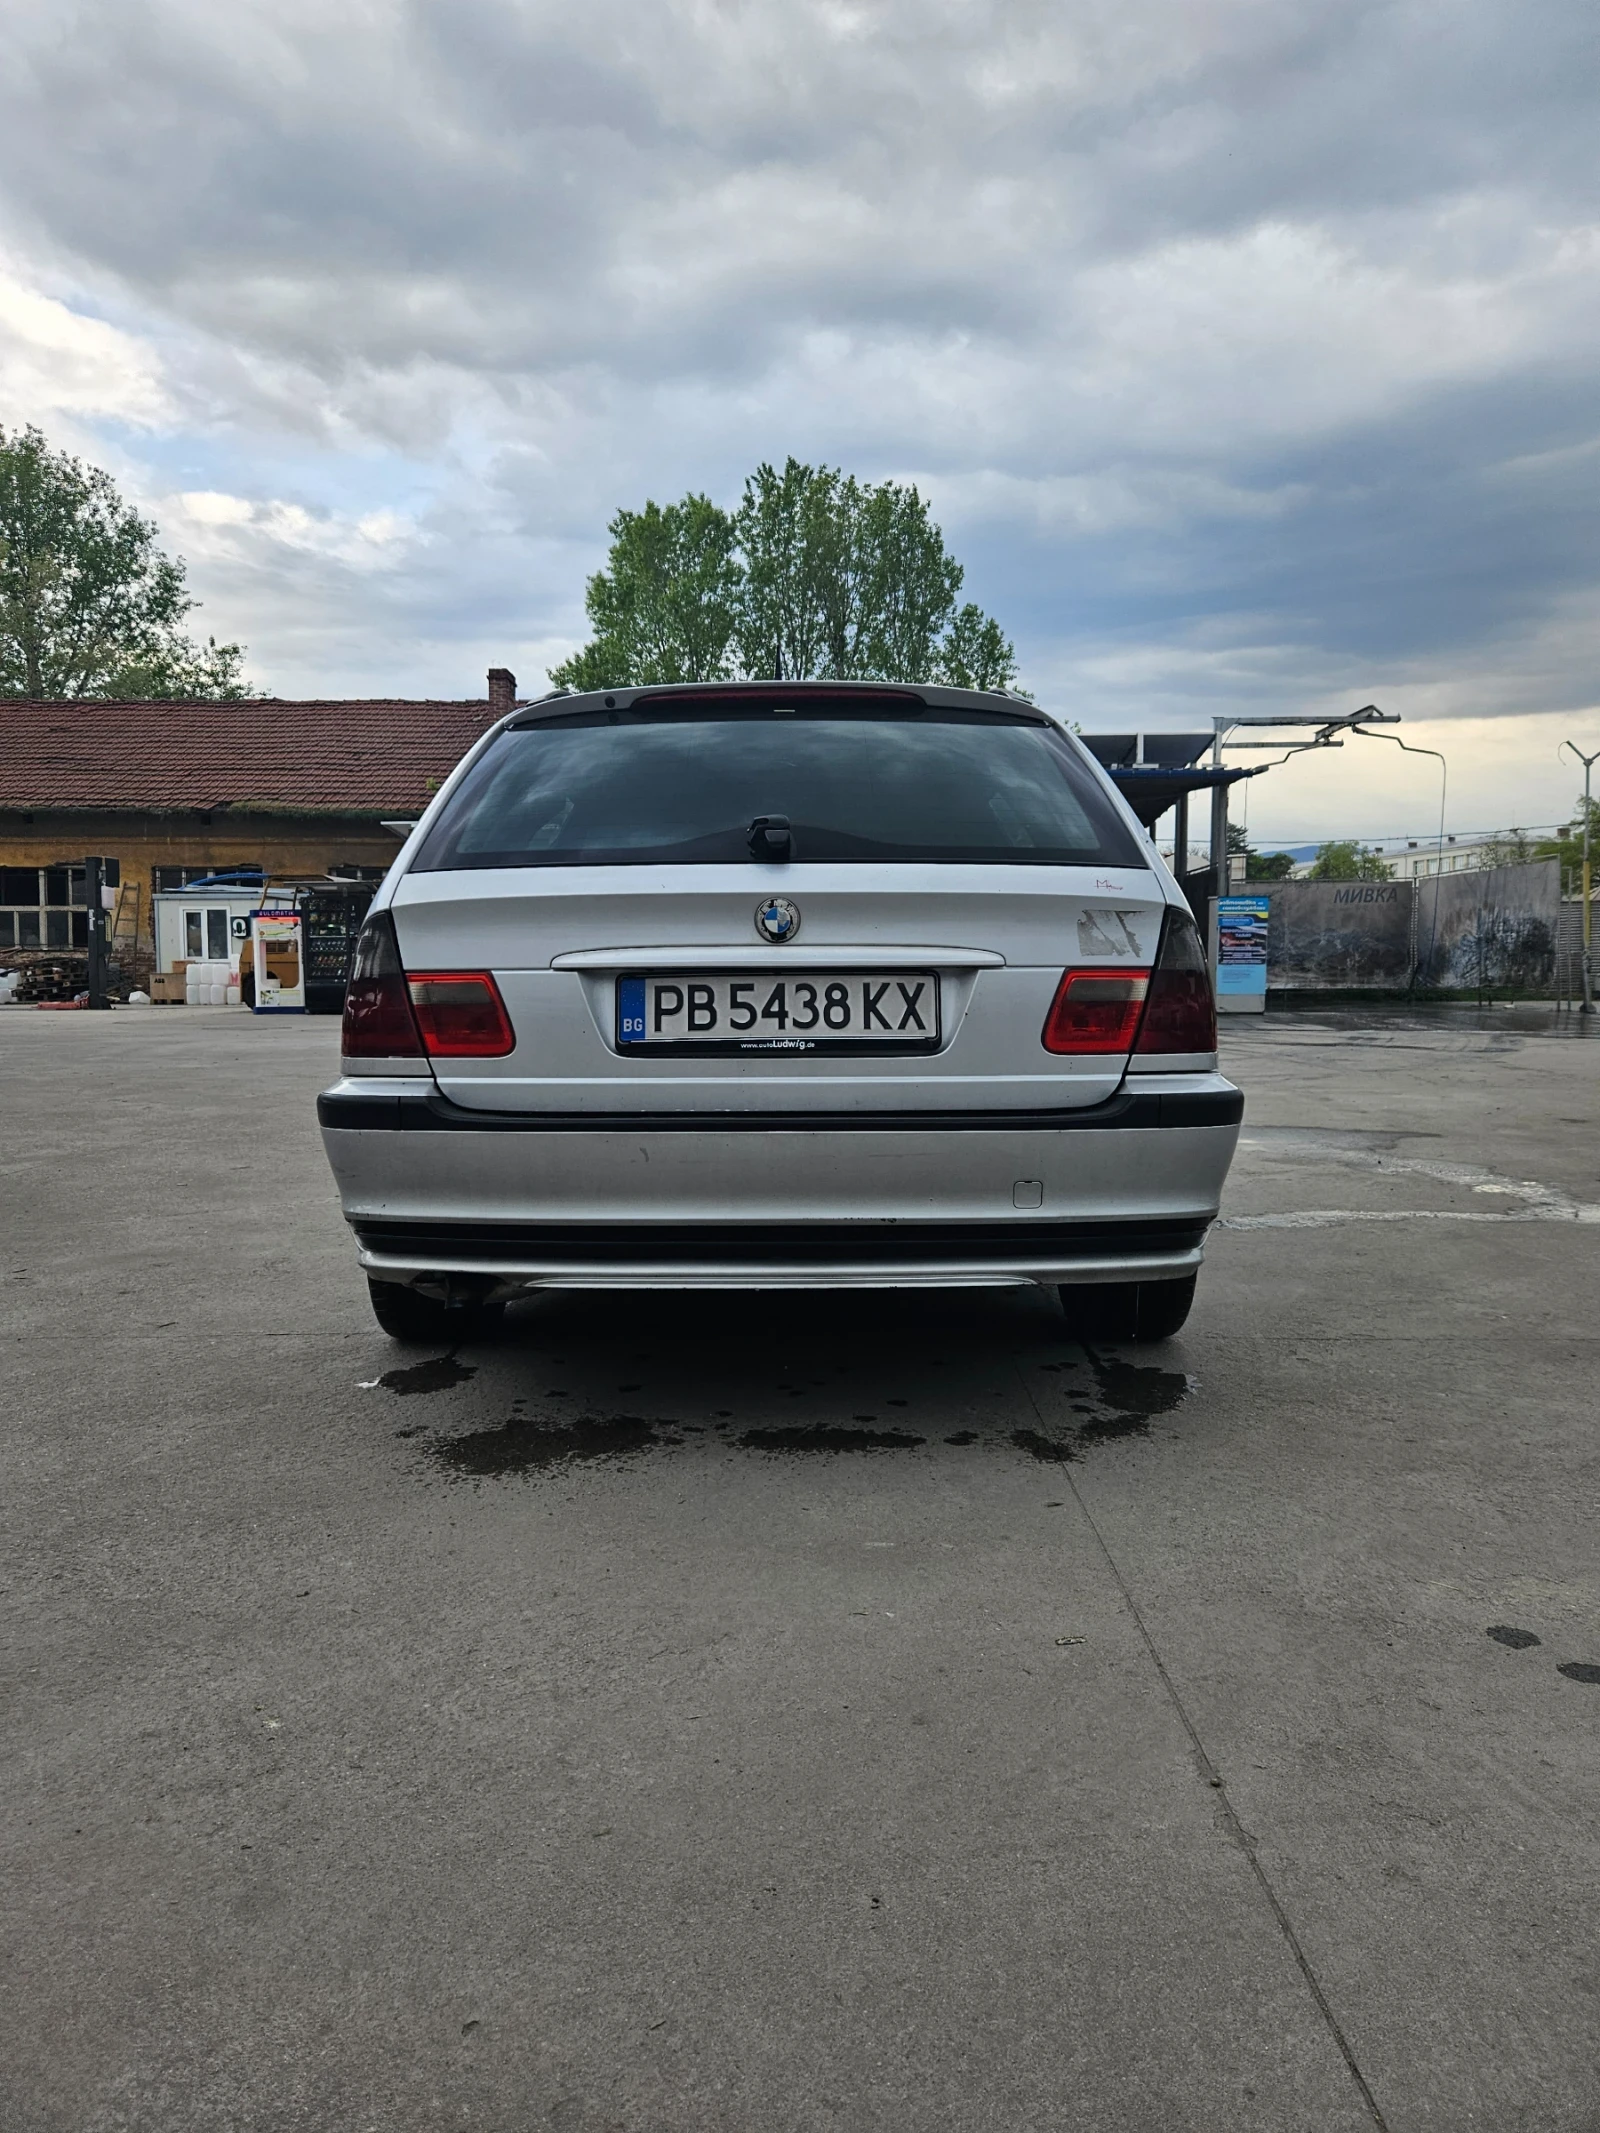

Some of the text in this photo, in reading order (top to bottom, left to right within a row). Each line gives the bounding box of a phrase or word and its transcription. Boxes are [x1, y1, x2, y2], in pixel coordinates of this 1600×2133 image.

[1333, 887, 1398, 904] МИВКА
[653, 982, 926, 1032] PB 5438 KX
[623, 1018, 643, 1032] BG
[740, 1039, 816, 1050] www.autoLudwig.de
